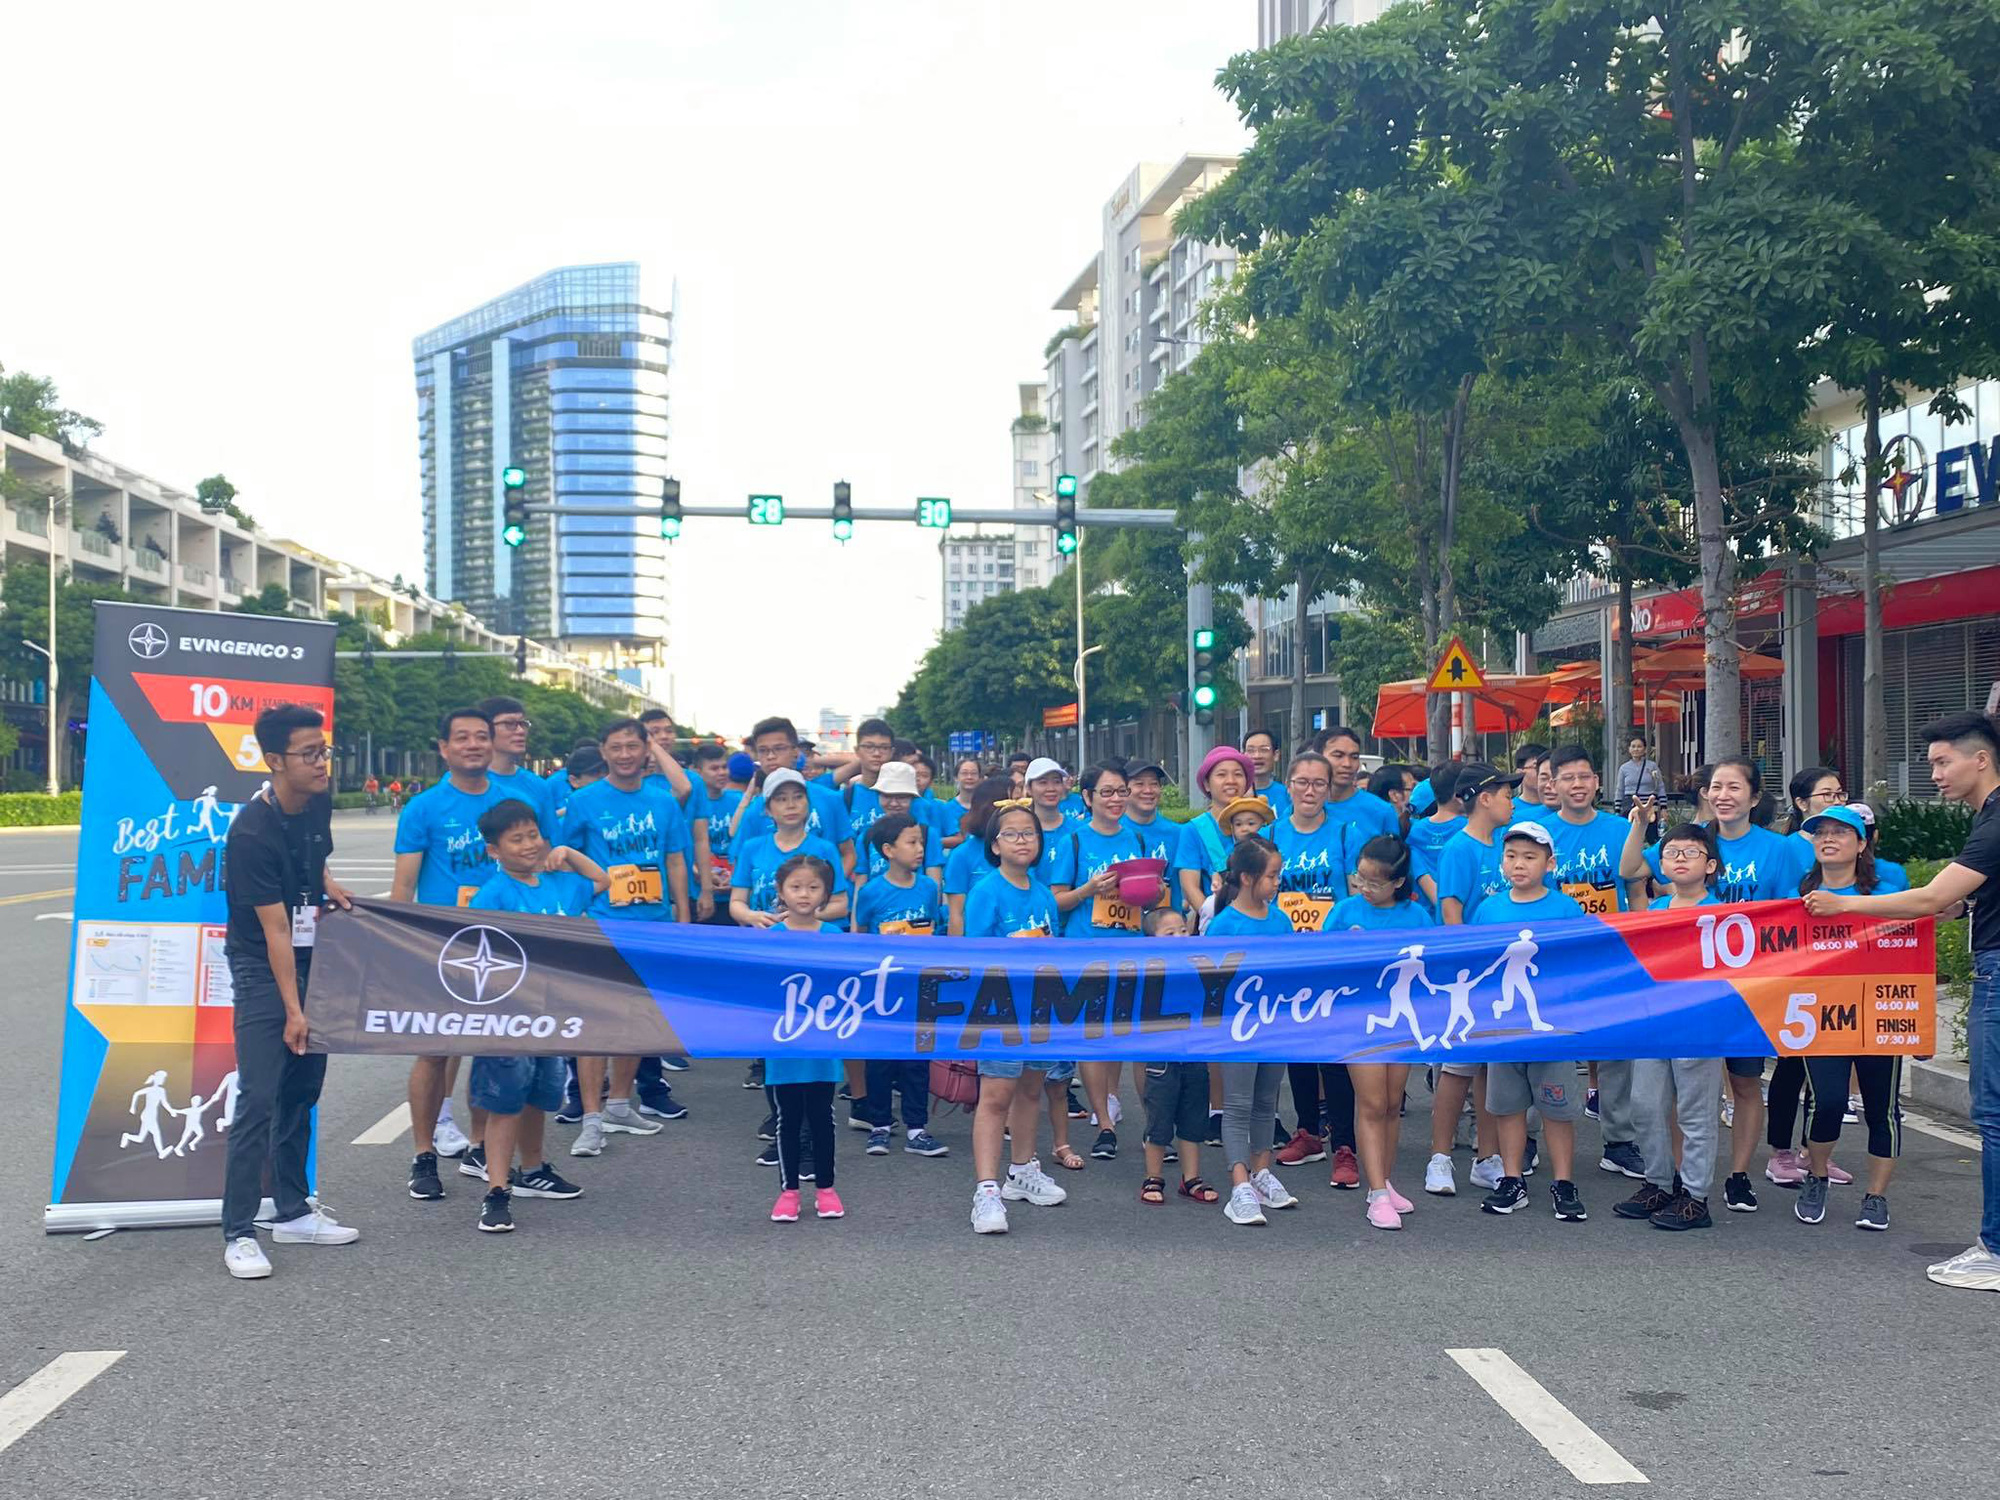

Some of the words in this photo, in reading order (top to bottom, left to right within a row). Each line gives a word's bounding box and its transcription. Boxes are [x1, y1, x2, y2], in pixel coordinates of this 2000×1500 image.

[750, 498, 782, 524] 28
[920, 500, 948, 527] 30
[180, 637, 289, 659] EVNGENCO
[291, 646, 304, 660] 3
[189, 683, 228, 717] 10
[230, 697, 254, 711] KM
[235, 734, 263, 767] 5
[113, 803, 180, 854] Best
[627, 880, 648, 895] 011
[1280, 869, 1333, 893] AMILY
[1108, 904, 1131, 921] 001
[1291, 910, 1320, 924] 009
[1696, 913, 1756, 969] 10
[1760, 925, 1798, 952] KM
[1812, 925, 1853, 940] START
[1875, 922, 1915, 937] FINISH
[1813, 941, 1842, 951] 06:00
[1844, 940, 1858, 949] AM
[1877, 938, 1903, 949] 08:30
[1905, 938, 1918, 948] AM
[773, 955, 904, 1042] Best
[915, 951, 1246, 1053] FAMILY
[1876, 984, 1917, 998] START
[1231, 975, 1360, 1042] Ever
[1875, 1001, 1904, 1011] 06:00
[1906, 1001, 1919, 1010] AM
[365, 1010, 556, 1038] EVNGENCO
[561, 1016, 583, 1038] 3
[1779, 993, 1818, 1050] 5
[1821, 1004, 1857, 1031] KM
[1876, 1018, 1916, 1032] FINISH
[1876, 1035, 1905, 1045] 07:30
[1907, 1035, 1920, 1045] AM
